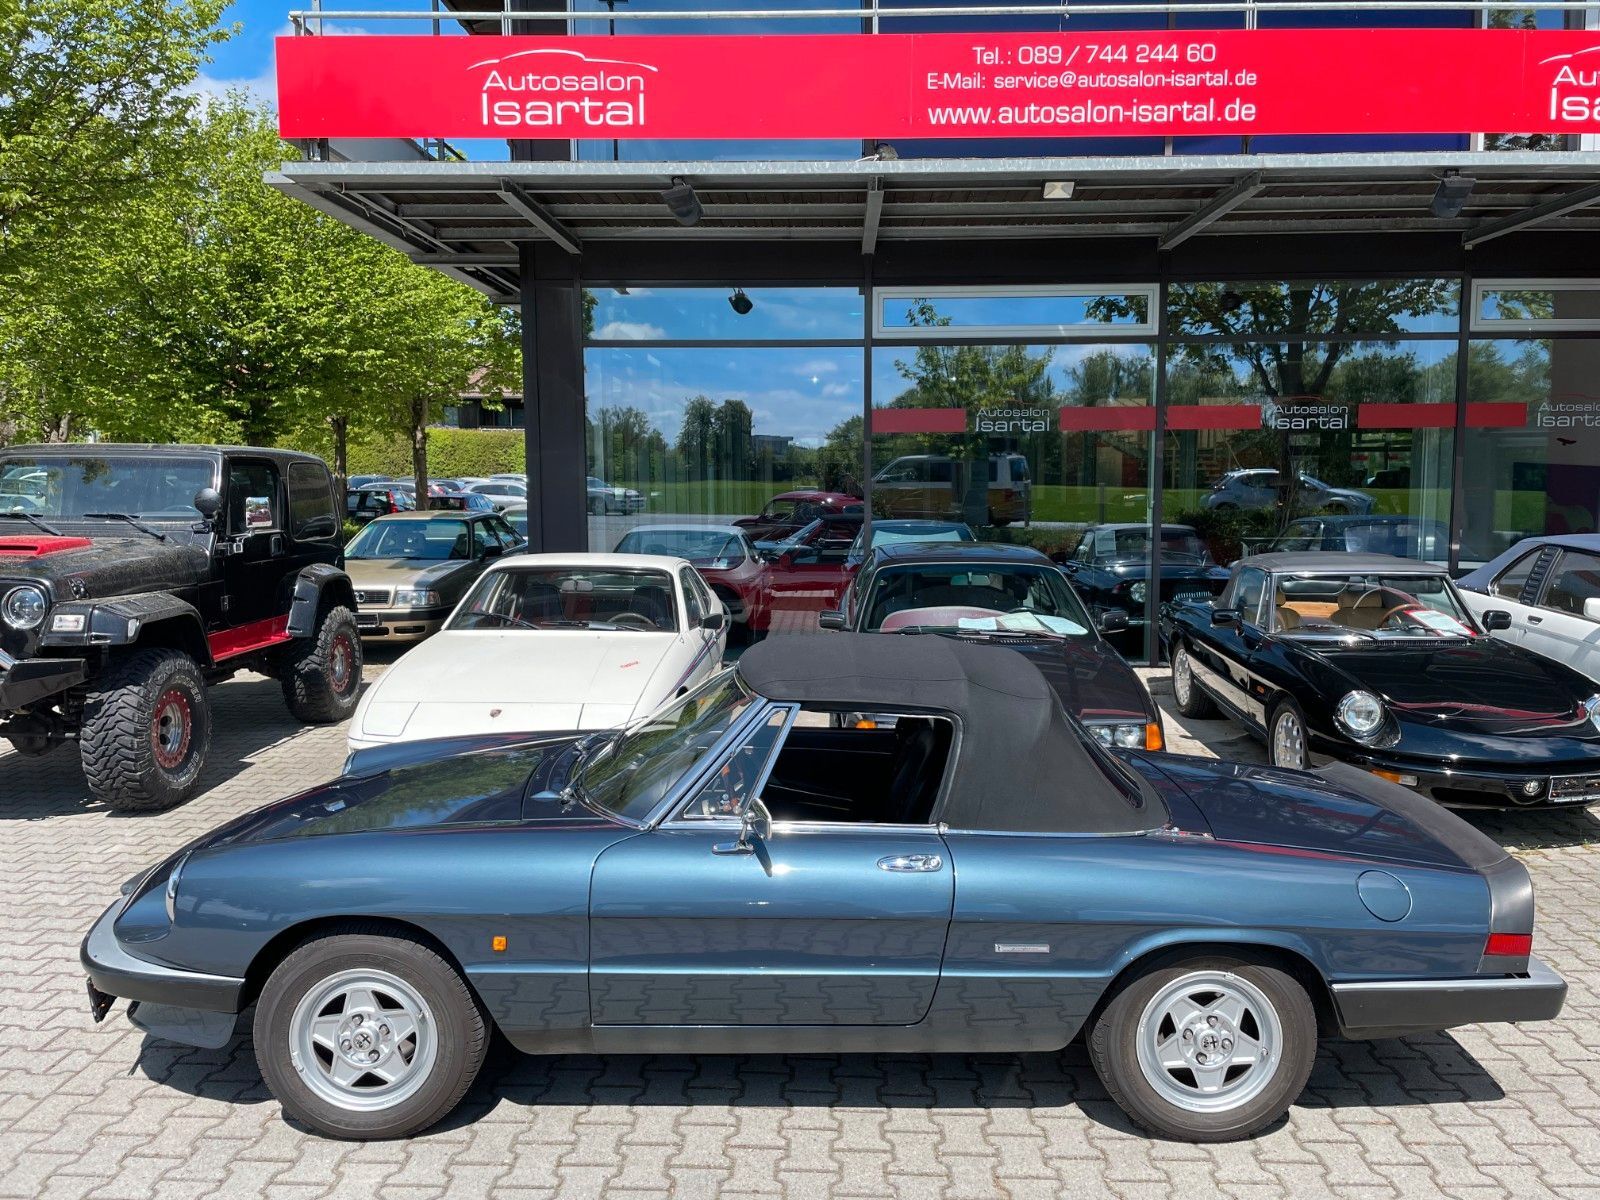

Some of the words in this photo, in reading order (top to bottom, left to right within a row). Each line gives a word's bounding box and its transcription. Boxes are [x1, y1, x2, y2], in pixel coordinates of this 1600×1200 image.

[972, 46, 1012, 65] Tel.:
[1018, 45, 1063, 64] 089
[1086, 44, 1129, 63] 744
[1135, 44, 1179, 63] 244
[1186, 43, 1217, 62] 60
[482, 70, 645, 91] Autosalon
[927, 72, 986, 90] E-Mail:
[994, 69, 1257, 89] service@autosalon-isartal.de
[1552, 65, 1600, 87] Au
[482, 92, 645, 126] Isartal
[927, 98, 1257, 125] www.autosalon-isartal.de
[1550, 87, 1600, 121] Is
[976, 407, 1050, 417] Autosalon
[1274, 404, 1349, 414] Autosalon
[975, 416, 1050, 432] Isartal
[1271, 414, 1348, 430] Isartal
